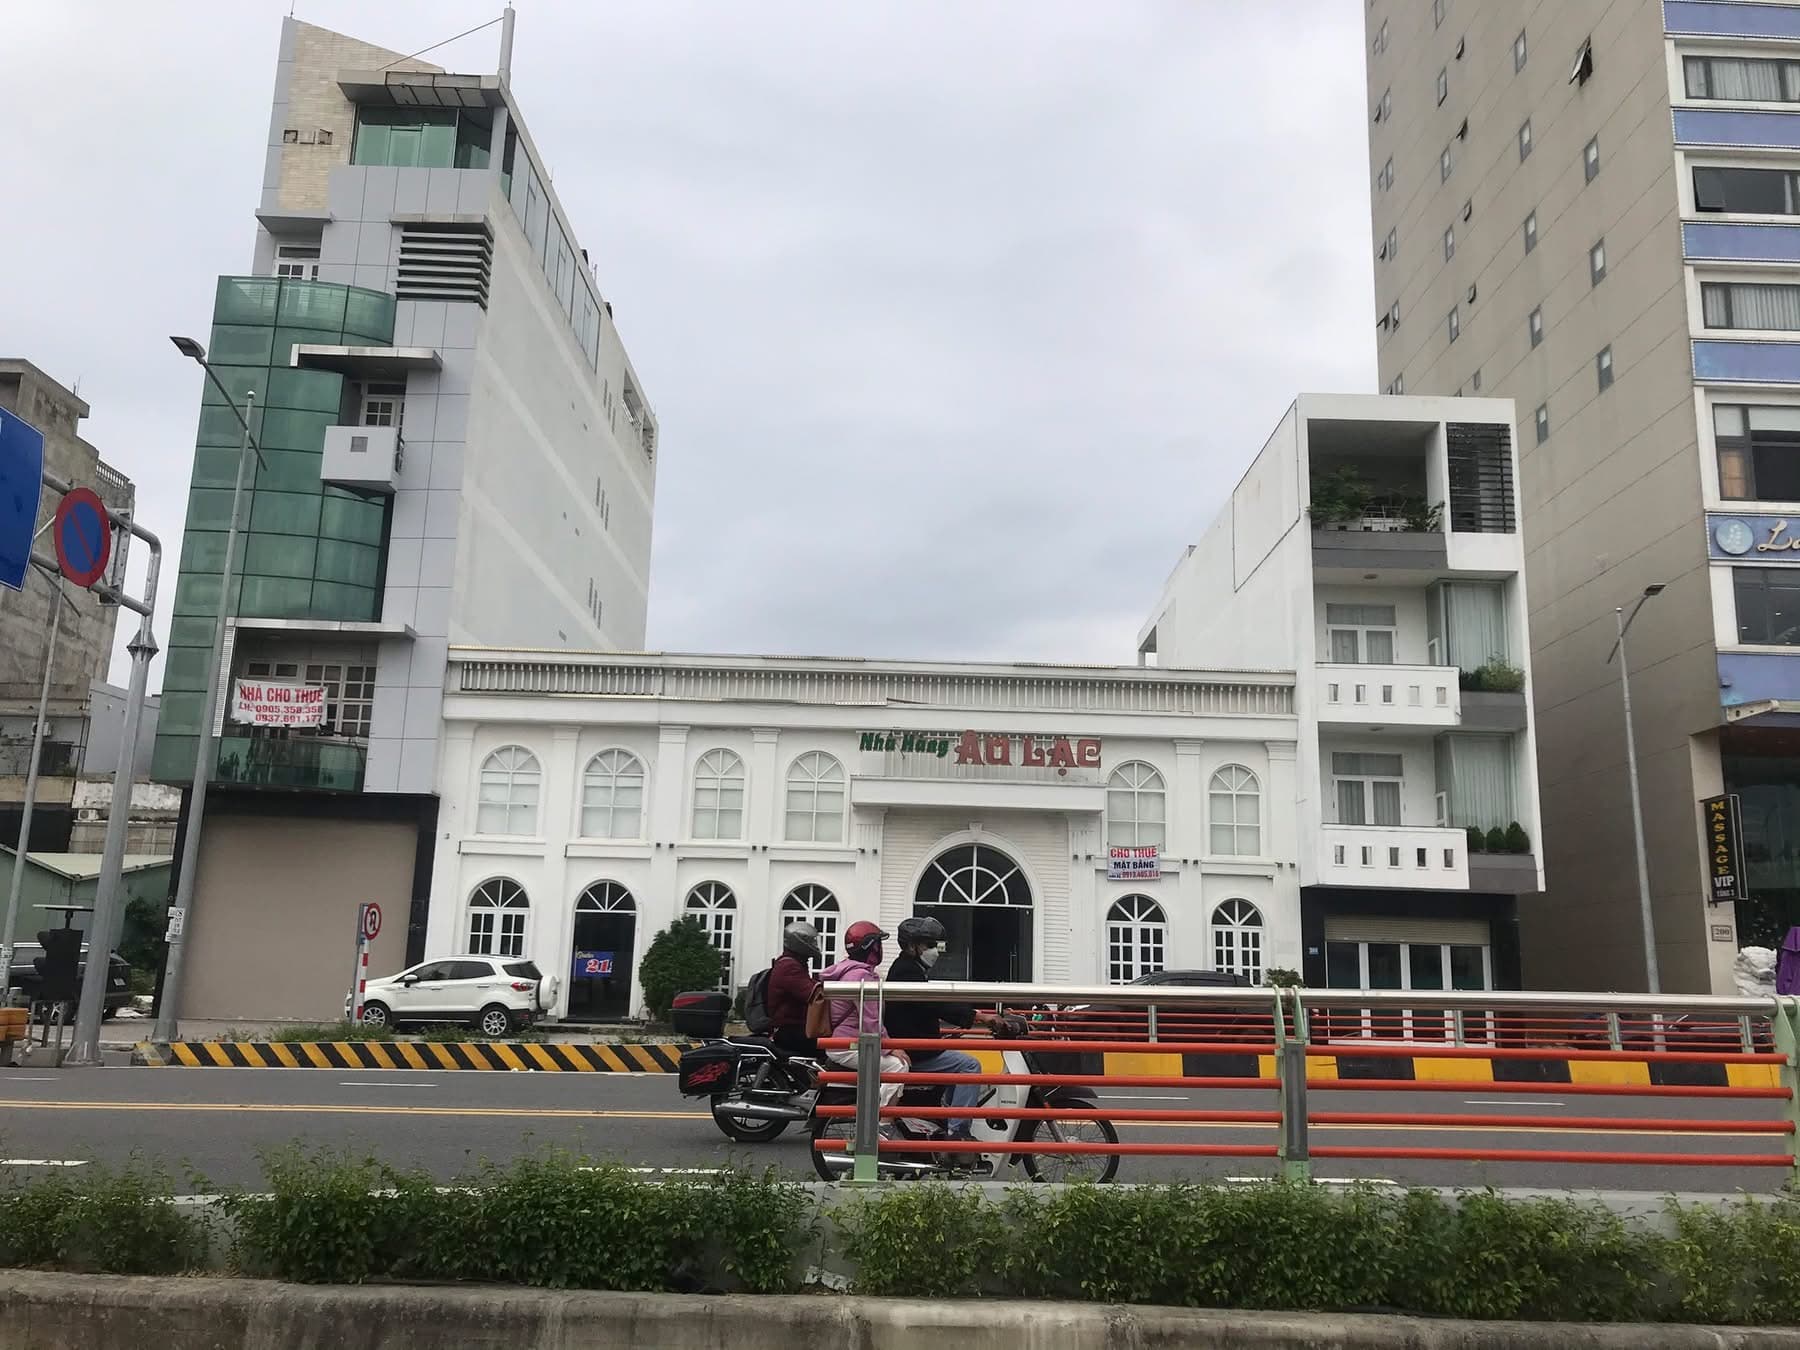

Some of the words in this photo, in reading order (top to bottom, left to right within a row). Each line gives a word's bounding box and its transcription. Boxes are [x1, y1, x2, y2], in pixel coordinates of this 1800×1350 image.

[267, 687, 291, 703] CHO
[295, 687, 324, 704] THUÊ
[1711, 801, 1729, 875] MASSAGE
[1110, 848, 1130, 858] CHO
[1714, 875, 1735, 888] VIP
